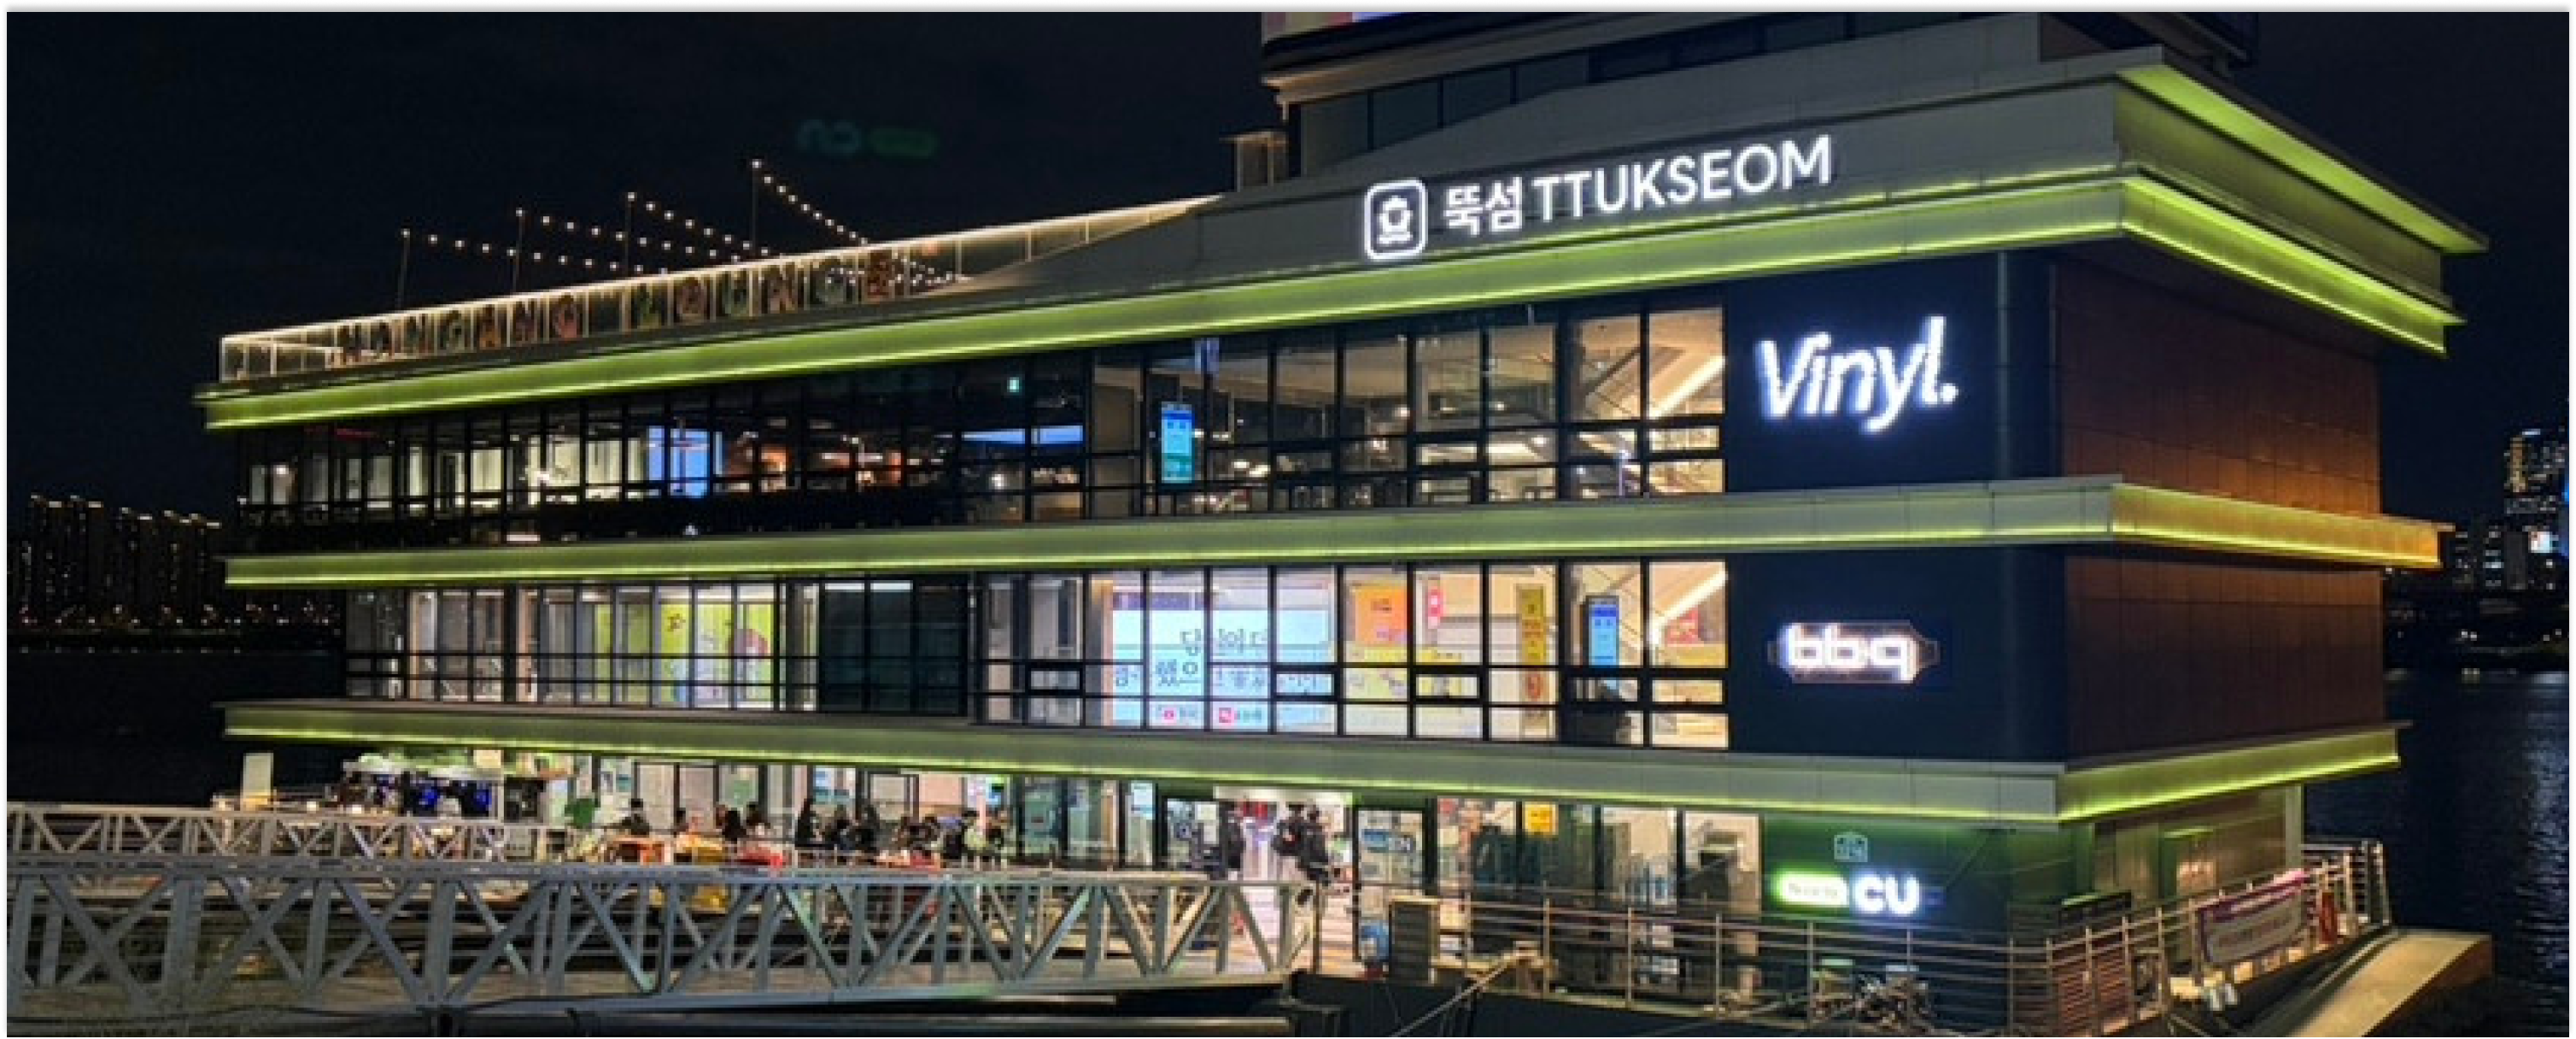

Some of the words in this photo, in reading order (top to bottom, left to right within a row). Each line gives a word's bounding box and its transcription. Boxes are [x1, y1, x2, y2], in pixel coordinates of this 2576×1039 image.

[1443, 176, 1522, 237] 뚝섬
[1531, 133, 1832, 222] TTUKSEOM
[1758, 315, 1958, 432] Vinyl.
[1785, 622, 1916, 681] bbq
[1853, 872, 1920, 916] CU
